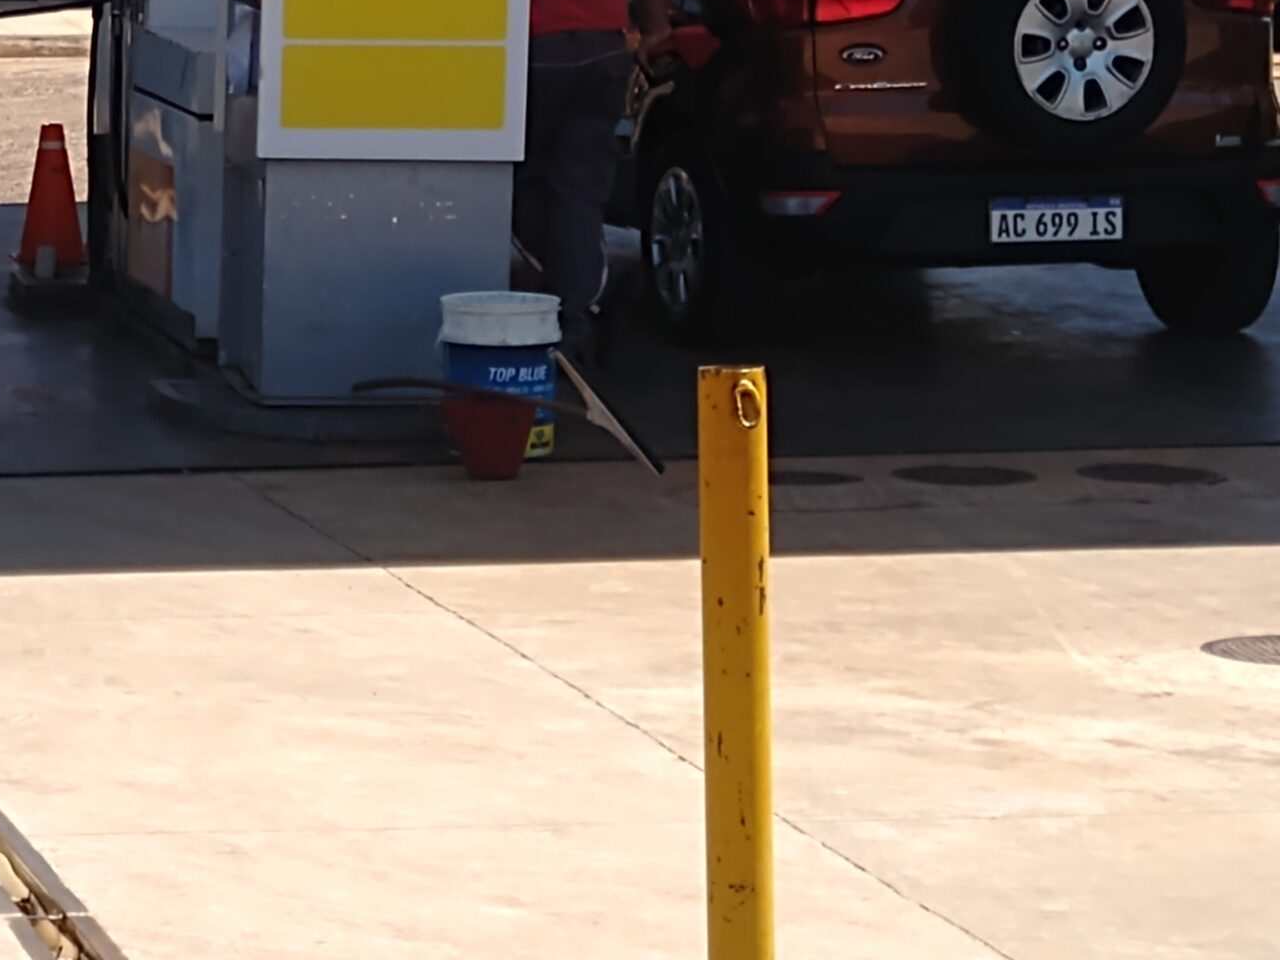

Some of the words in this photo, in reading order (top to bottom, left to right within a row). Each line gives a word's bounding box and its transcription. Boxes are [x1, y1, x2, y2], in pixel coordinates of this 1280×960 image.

[997, 213, 1026, 238] AC
[1035, 212, 1079, 238] 699
[1090, 211, 1117, 236] IS
[489, 367, 516, 383] TOP
[518, 365, 548, 382] BLUE
